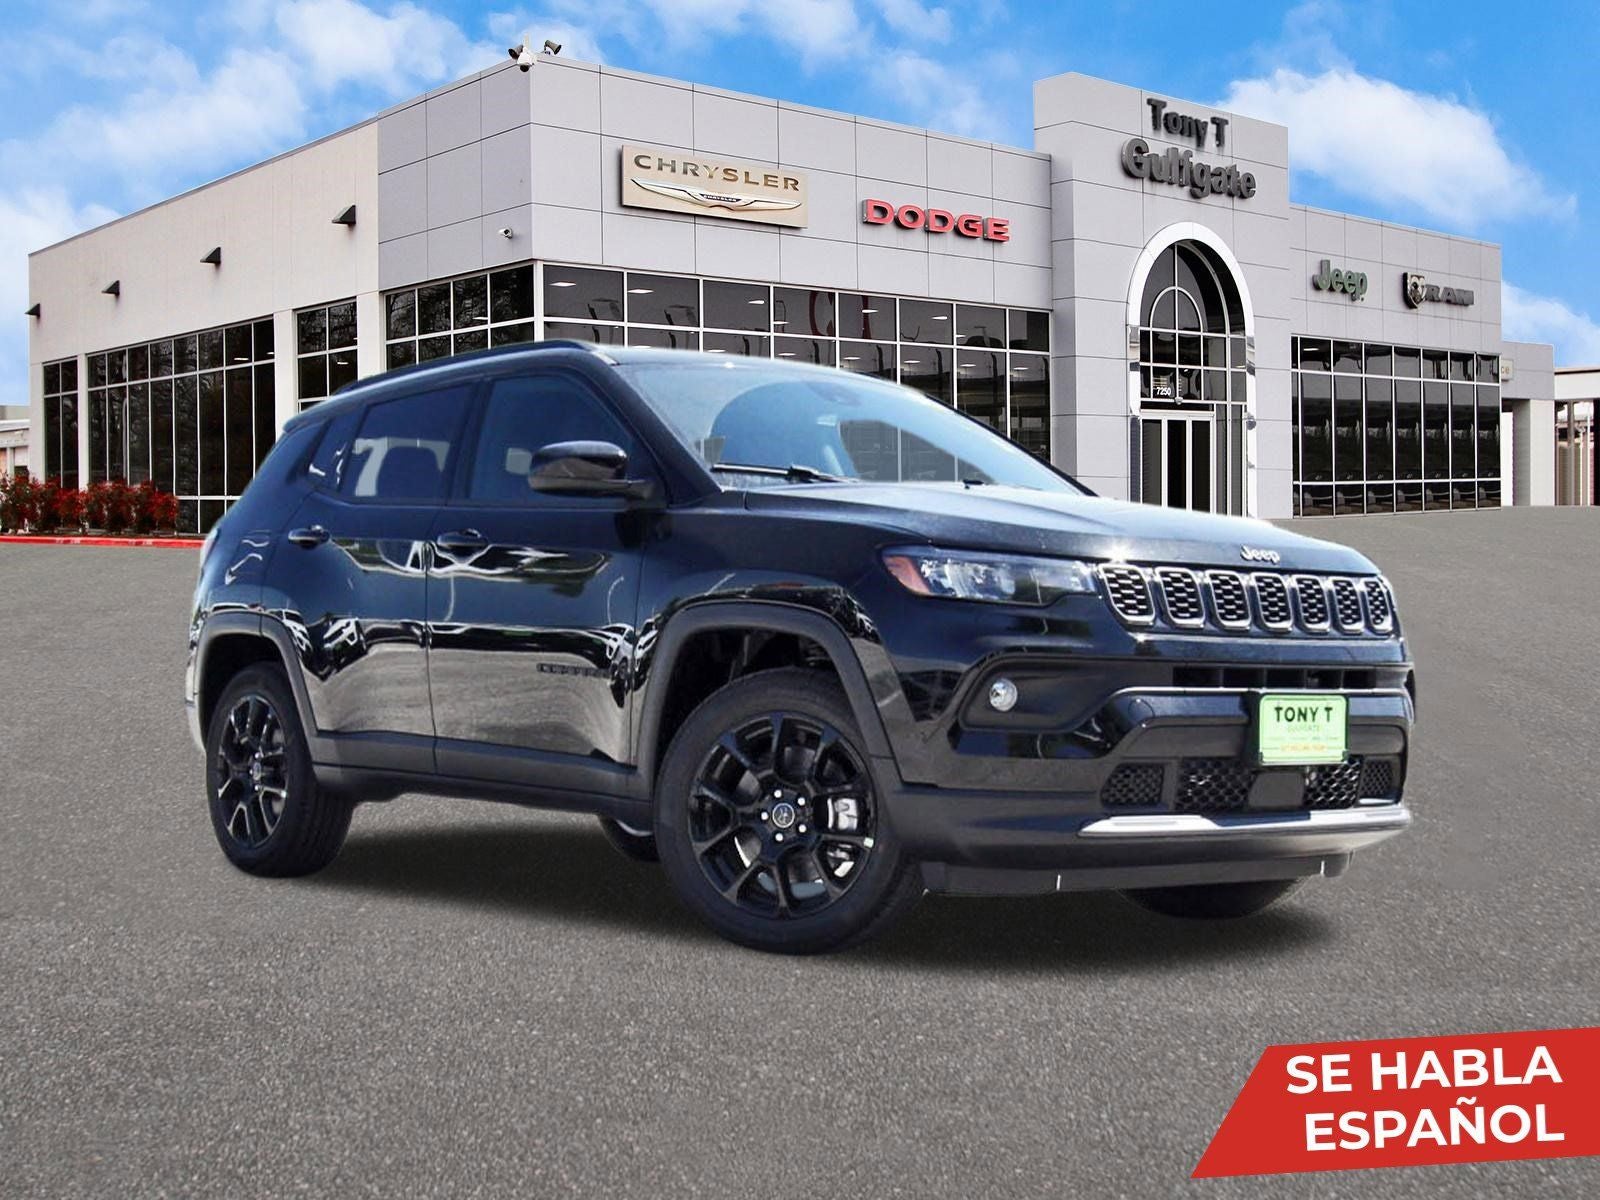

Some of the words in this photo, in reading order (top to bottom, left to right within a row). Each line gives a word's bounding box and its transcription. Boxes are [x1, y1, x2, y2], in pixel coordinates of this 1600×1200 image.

[1147, 98, 1208, 148] Tony
[1211, 116, 1229, 147] T
[633, 154, 800, 192] CHRYSLER
[1121, 138, 1256, 199] Gulfgate
[862, 198, 1010, 242] DODGE
[1312, 259, 1368, 301] Jeep
[1425, 284, 1475, 306] RAM
[1156, 387, 1172, 396] 7250
[1240, 544, 1280, 565] Jeep
[1274, 706, 1319, 723] TONY
[1324, 706, 1333, 723] T
